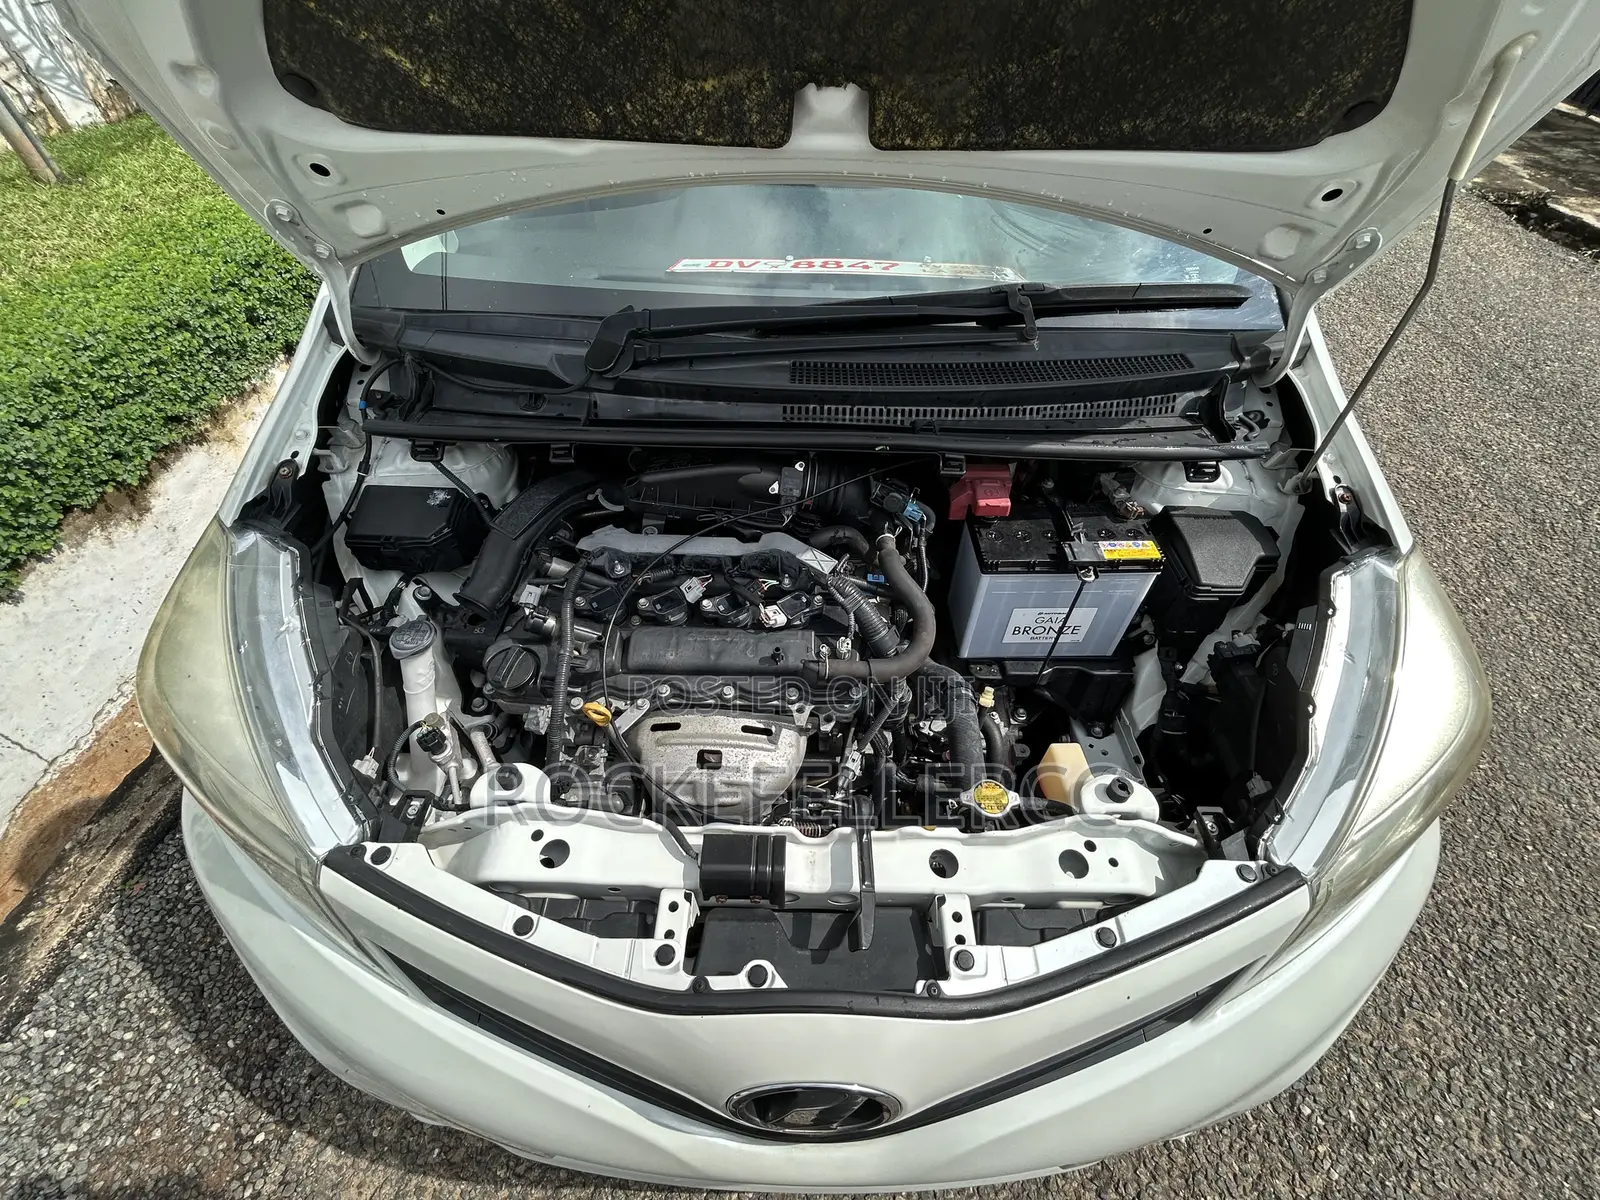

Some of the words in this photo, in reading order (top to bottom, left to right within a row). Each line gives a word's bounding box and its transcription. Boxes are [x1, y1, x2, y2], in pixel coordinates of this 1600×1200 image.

[790, 260, 900, 271] 8847
[1034, 616, 1067, 625] GAIA
[1012, 625, 1081, 635] BRONZE
